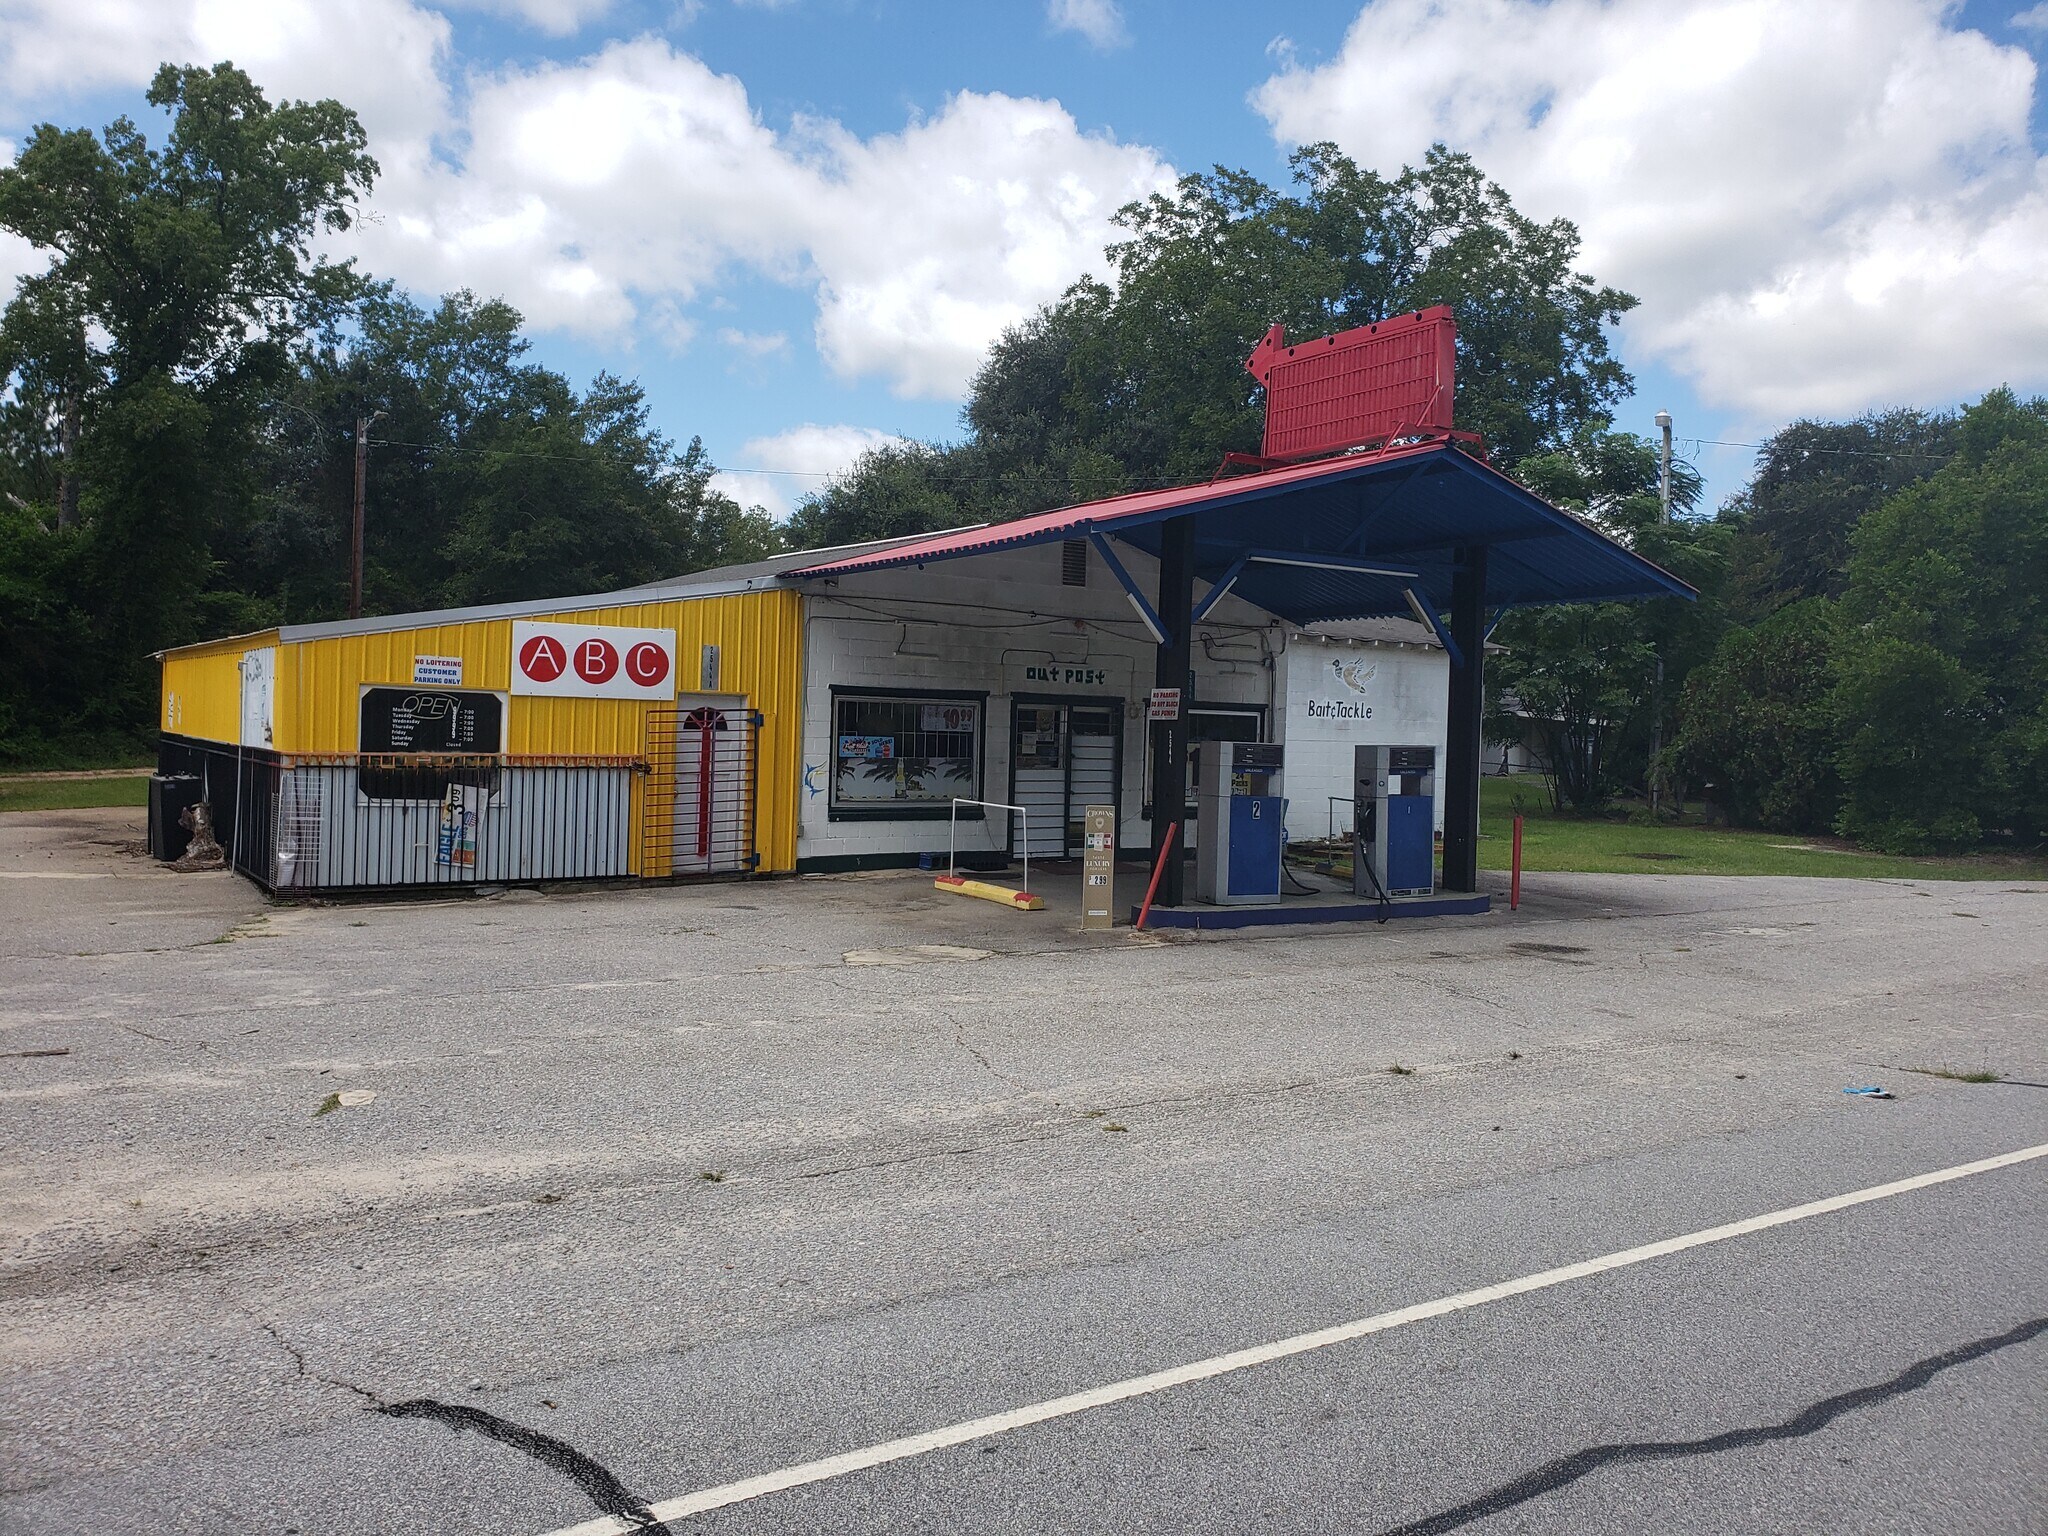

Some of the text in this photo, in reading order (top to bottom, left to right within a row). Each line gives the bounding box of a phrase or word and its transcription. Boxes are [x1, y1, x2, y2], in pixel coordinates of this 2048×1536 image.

[426, 659, 462, 668] LOITERING
[418, 667, 457, 676] CUSTOMER
[414, 676, 442, 684] PARKING
[402, 695, 462, 715] OPEN
[1253, 801, 1260, 819] 2
